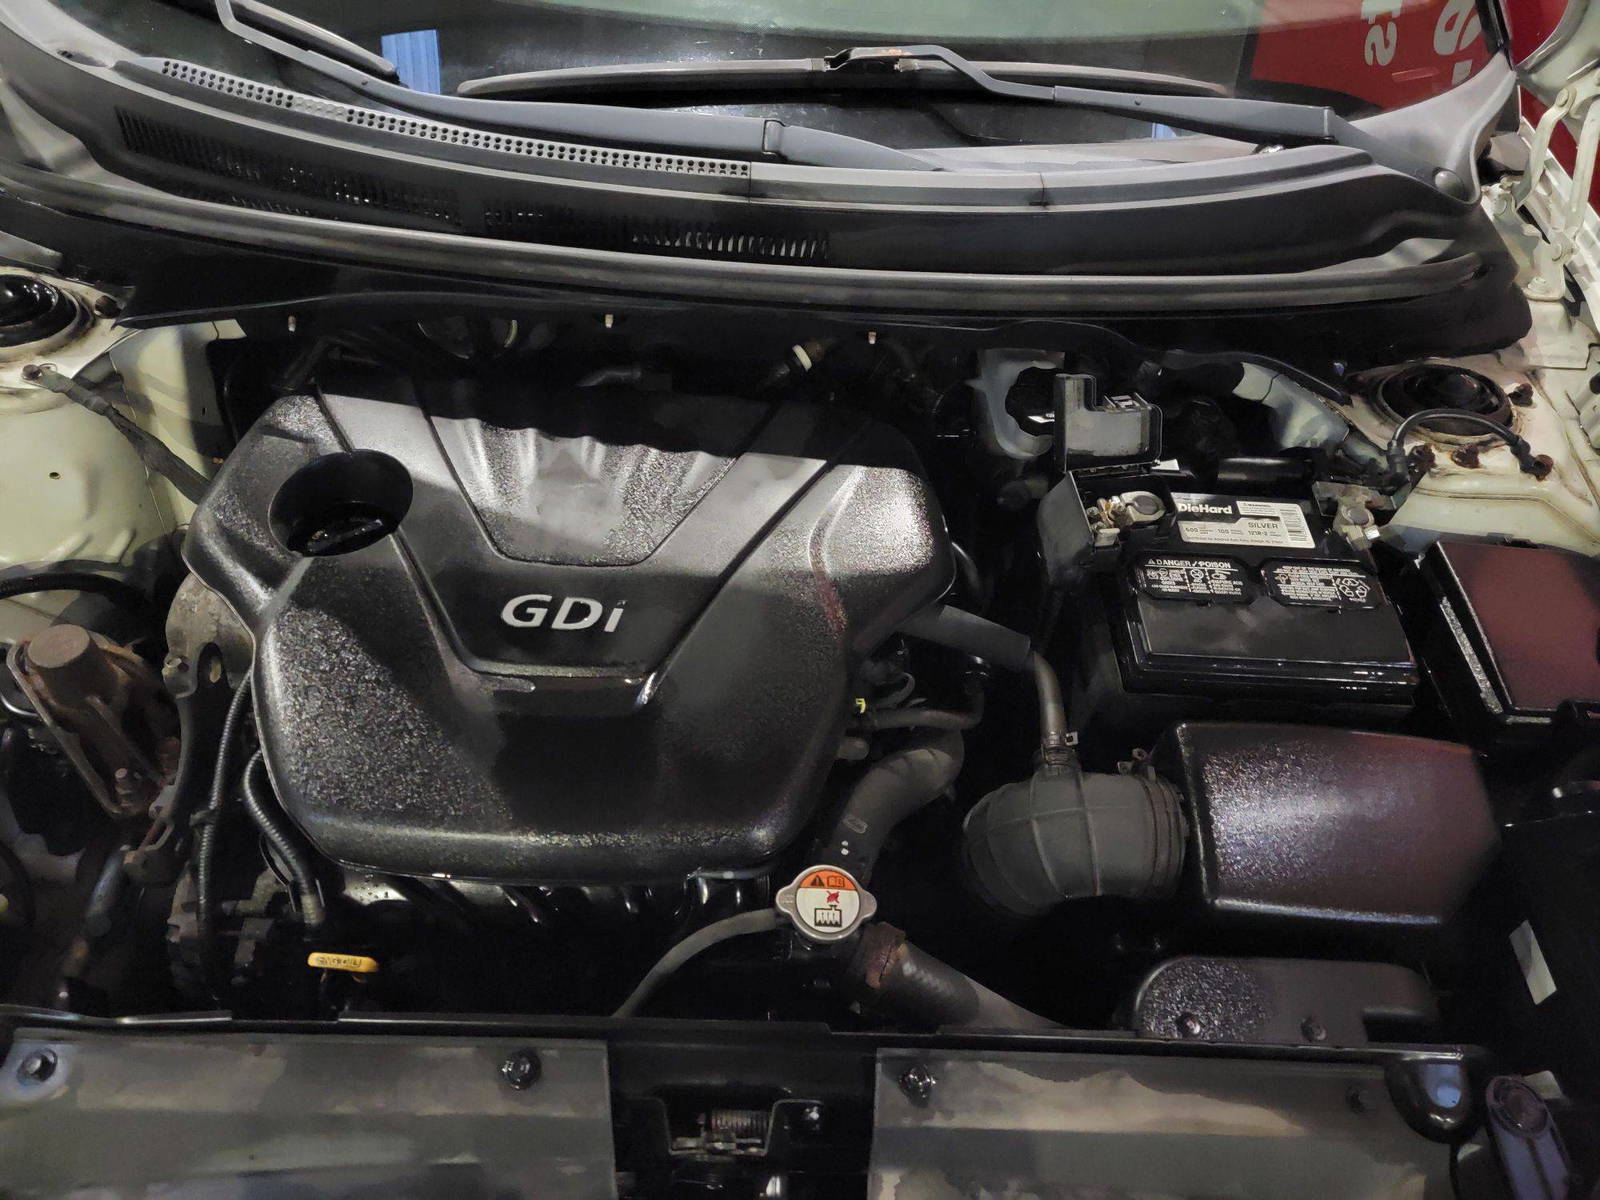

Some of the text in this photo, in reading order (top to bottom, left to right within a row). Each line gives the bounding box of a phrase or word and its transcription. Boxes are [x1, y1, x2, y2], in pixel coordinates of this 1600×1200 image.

[1177, 503, 1233, 515] DieHard
[1248, 521, 1279, 530] SILVER
[501, 593, 627, 633] GDi
